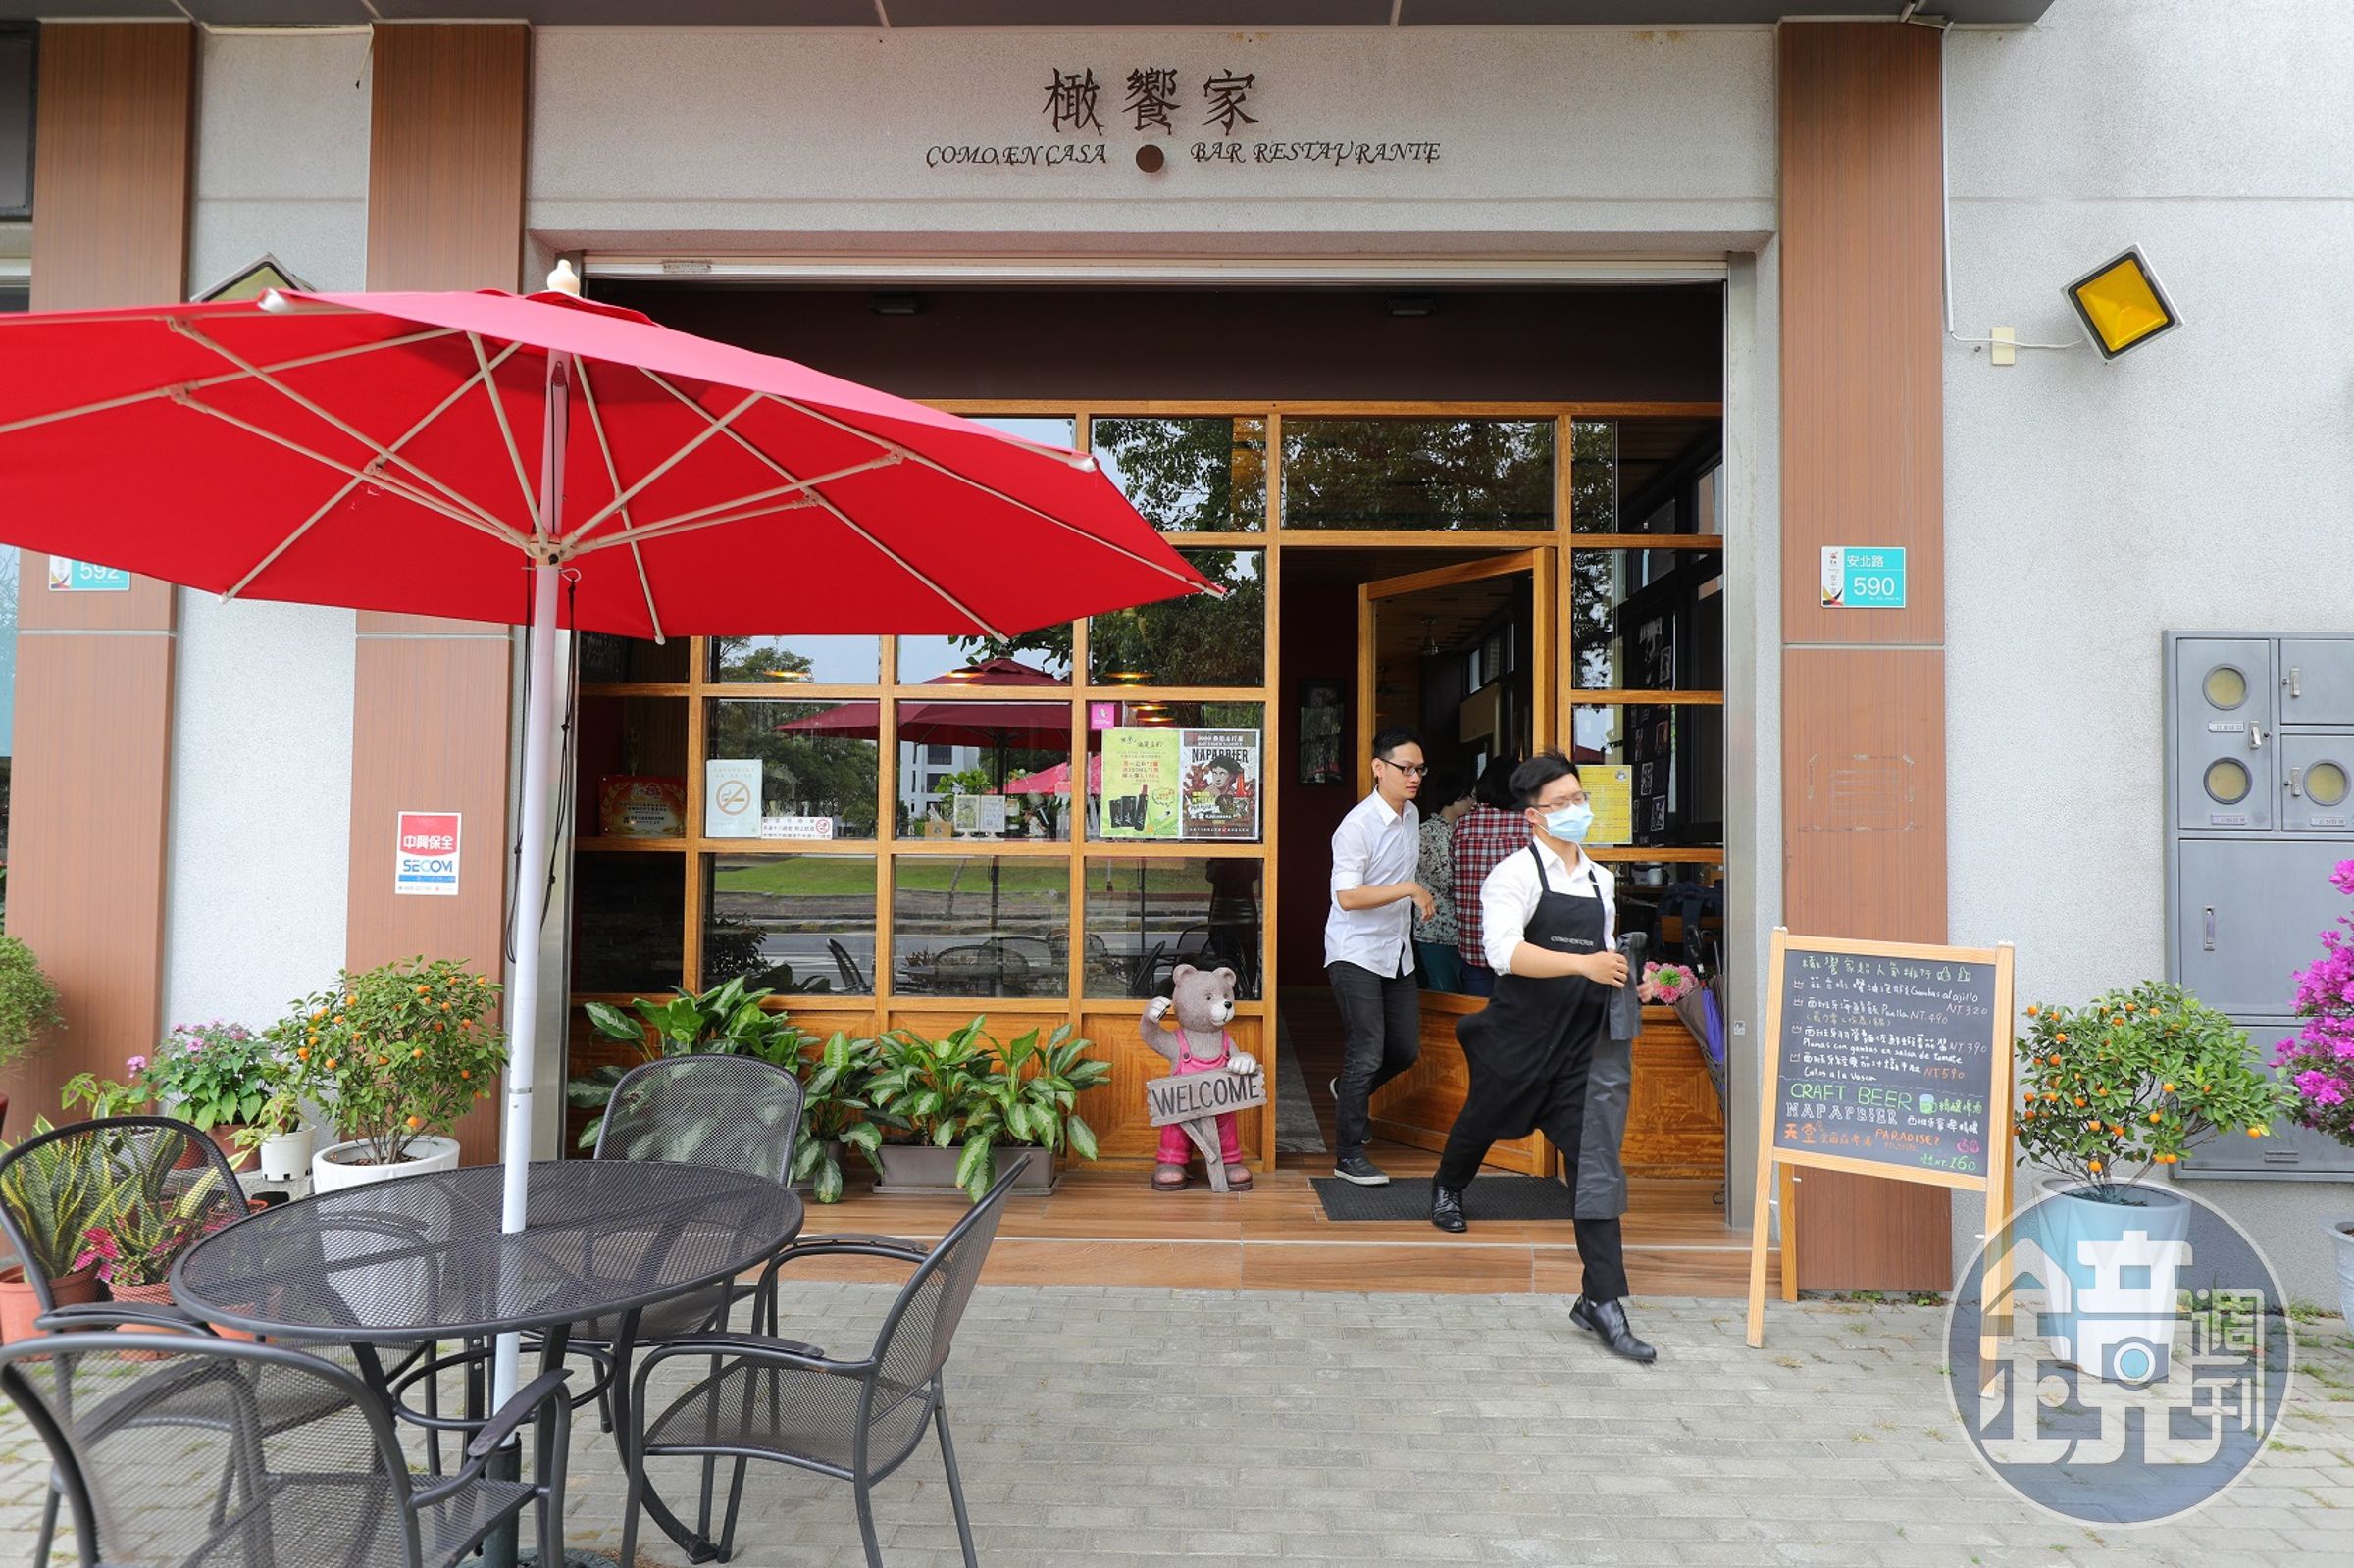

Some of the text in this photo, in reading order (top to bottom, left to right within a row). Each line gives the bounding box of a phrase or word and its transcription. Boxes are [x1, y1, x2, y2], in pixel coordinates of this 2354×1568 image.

[1043, 67, 1259, 136] 橄饗家
[1003, 145, 1043, 165] EN
[1046, 144, 1106, 166] CASA
[1190, 141, 1441, 166] BAR RESTAURANTE
[1846, 555, 1884, 568] 安北路
[1853, 576, 1895, 596] 590
[403, 835, 454, 850] 中興保全
[403, 859, 453, 873] SECOM
[1919, 1050, 1931, 1061] de
[1151, 1073, 1260, 1117] WELCOME
[1790, 1083, 1913, 1111] CRAFT BEER
